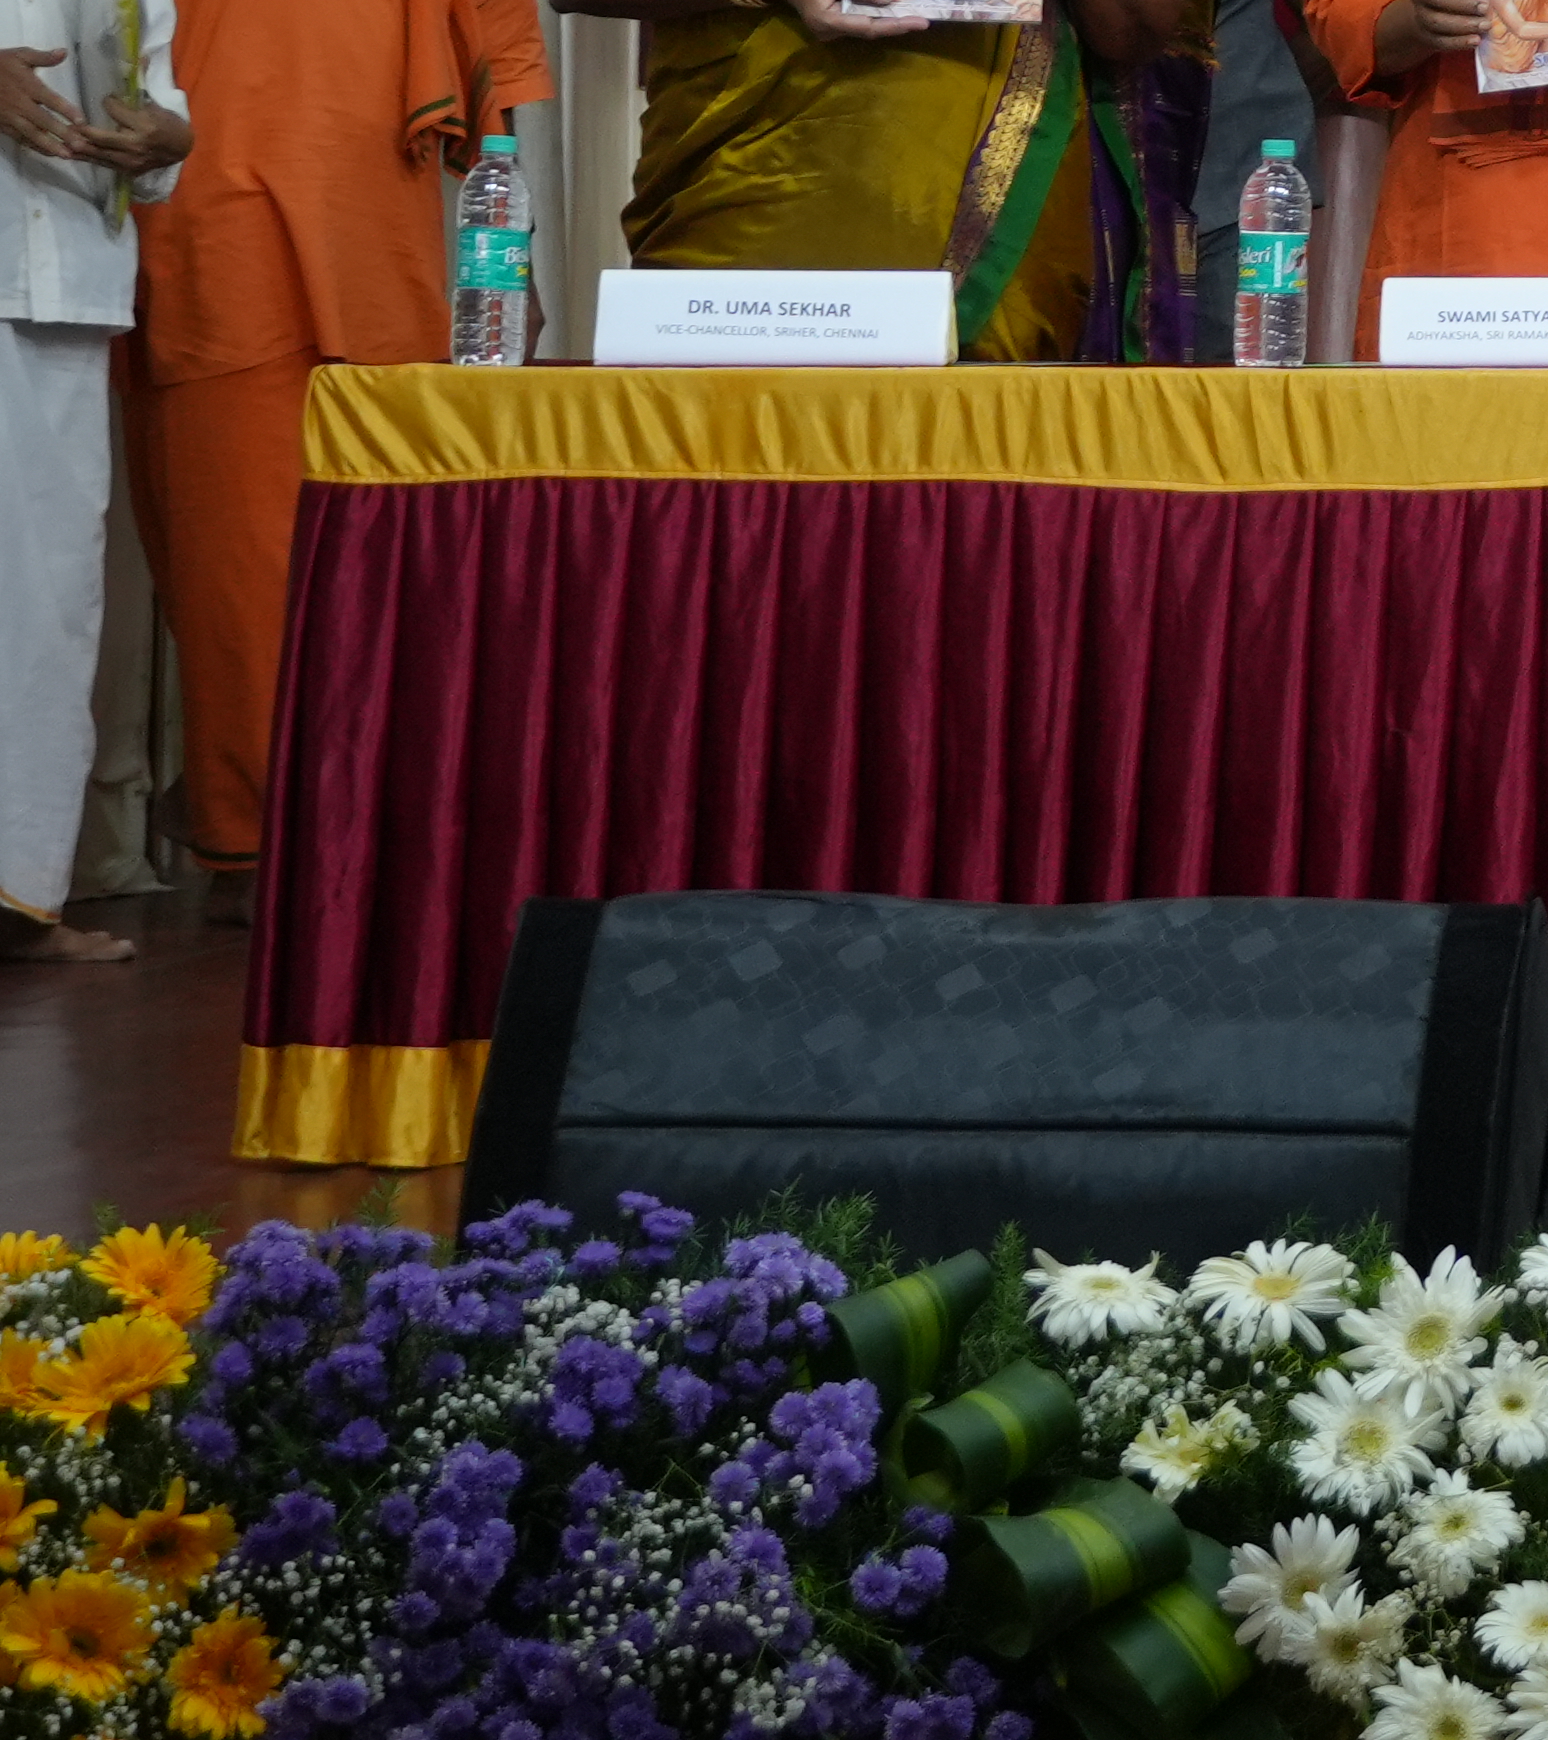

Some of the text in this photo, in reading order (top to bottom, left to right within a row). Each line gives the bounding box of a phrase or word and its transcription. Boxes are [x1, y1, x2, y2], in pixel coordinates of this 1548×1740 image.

[687, 300, 852, 317] DR. UMA SEKHAR
[1437, 311, 1496, 323] SWAMI
[655, 324, 770, 337] VICE-CHANCELLOR,
[824, 327, 880, 339] CHENNAI
[1407, 330, 1482, 341] ADHYAKSHA,
[1486, 331, 1504, 340] SRI
